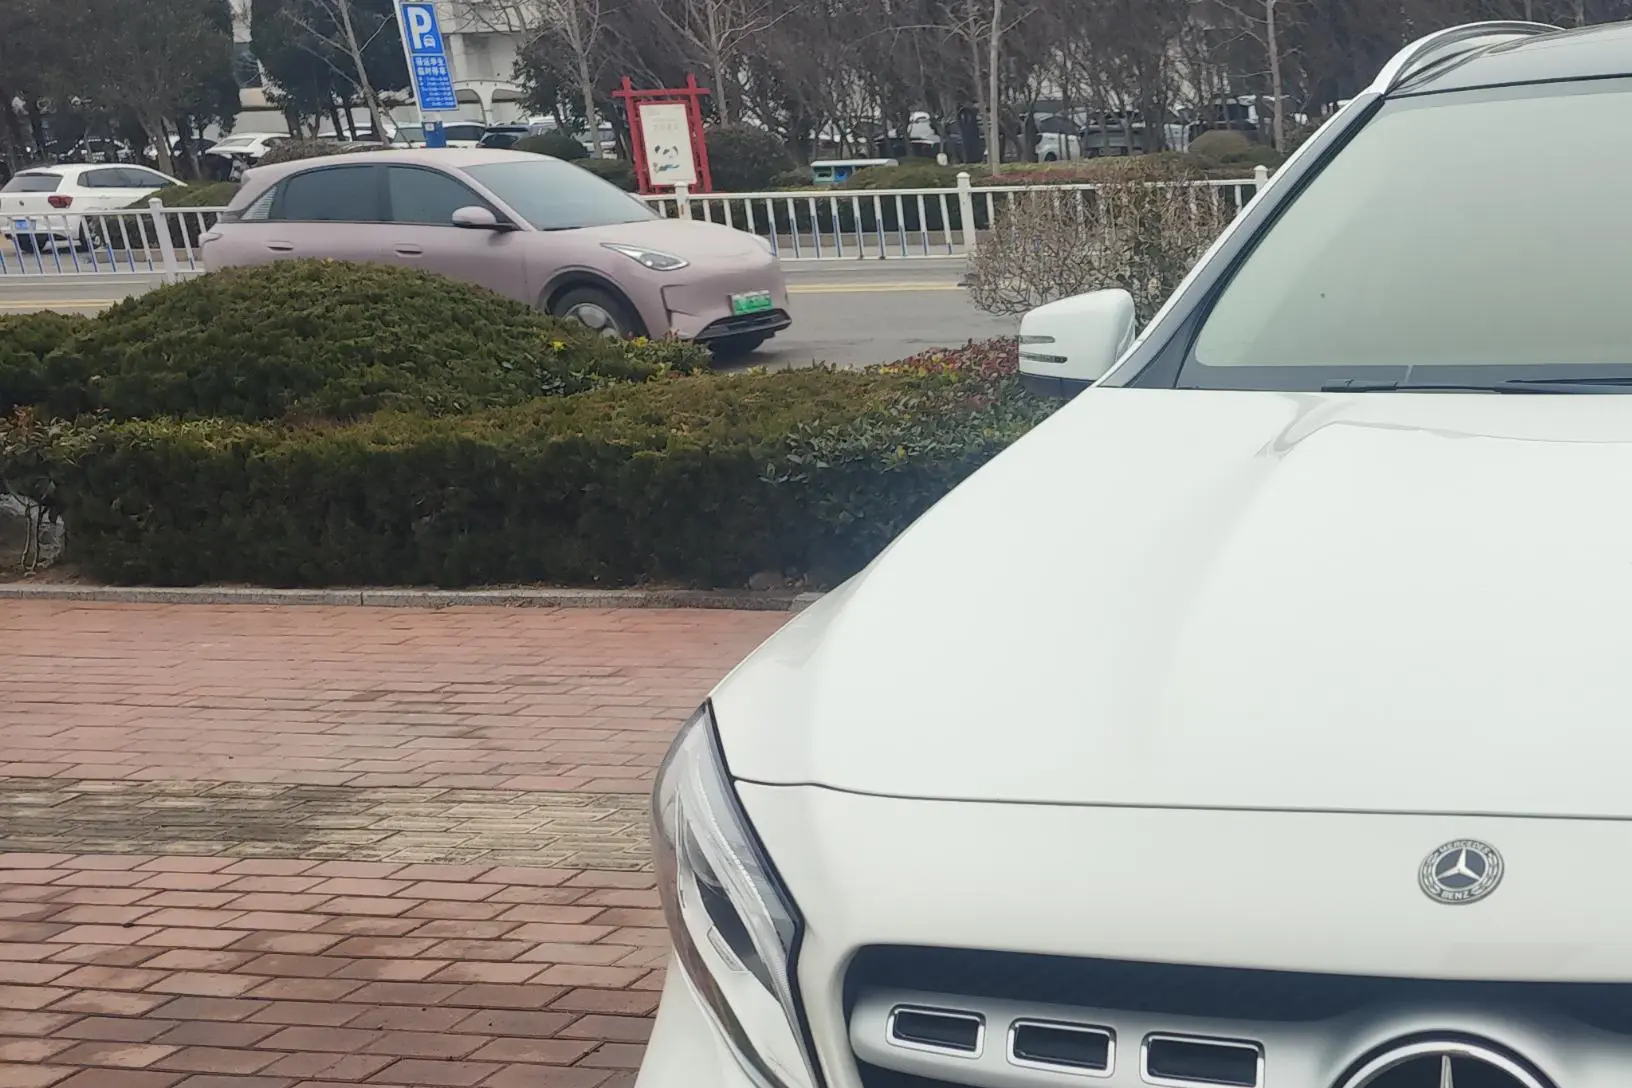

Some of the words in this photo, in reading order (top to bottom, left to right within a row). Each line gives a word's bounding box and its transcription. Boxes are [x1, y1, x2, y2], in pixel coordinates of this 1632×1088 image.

[407, 6, 432, 49] P
[1439, 840, 1490, 854] MERCEDES
[1441, 890, 1471, 901] BENZ
